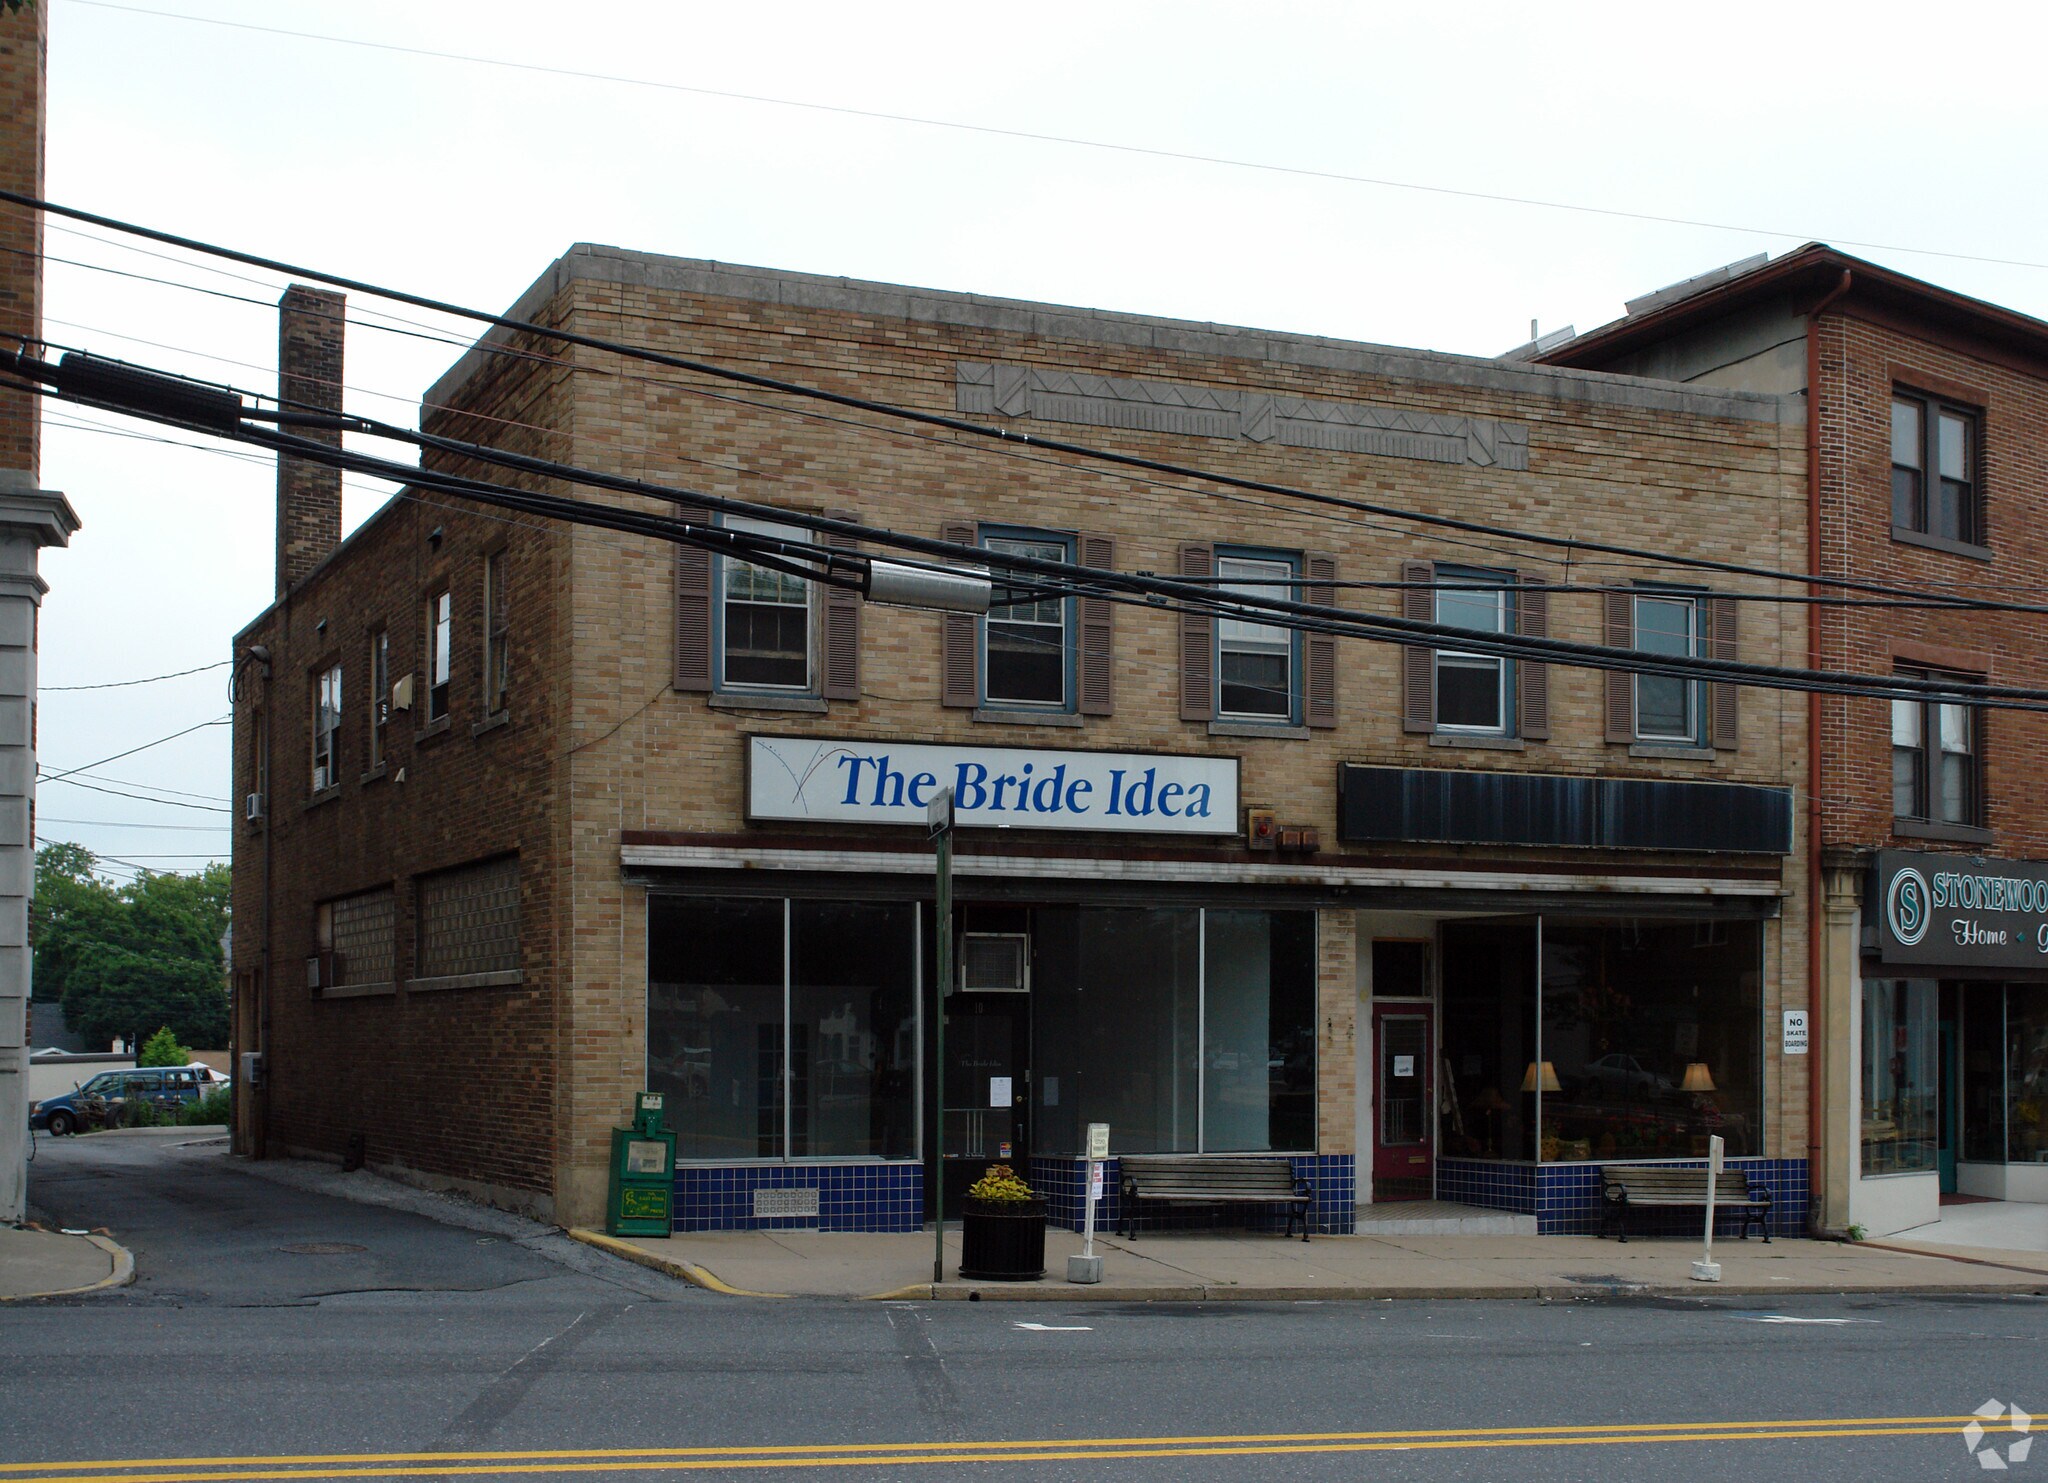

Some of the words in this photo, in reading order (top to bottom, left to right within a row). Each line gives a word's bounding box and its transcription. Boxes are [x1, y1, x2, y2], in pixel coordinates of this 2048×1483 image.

[837, 755, 936, 808] The
[955, 763, 1093, 813] Bride
[1104, 767, 1211, 818] Idea
[1900, 882, 1919, 931] S
[1933, 872, 2048, 913] STONEWOO
[1951, 919, 2007, 946] Home
[1789, 1018, 1803, 1026] NO
